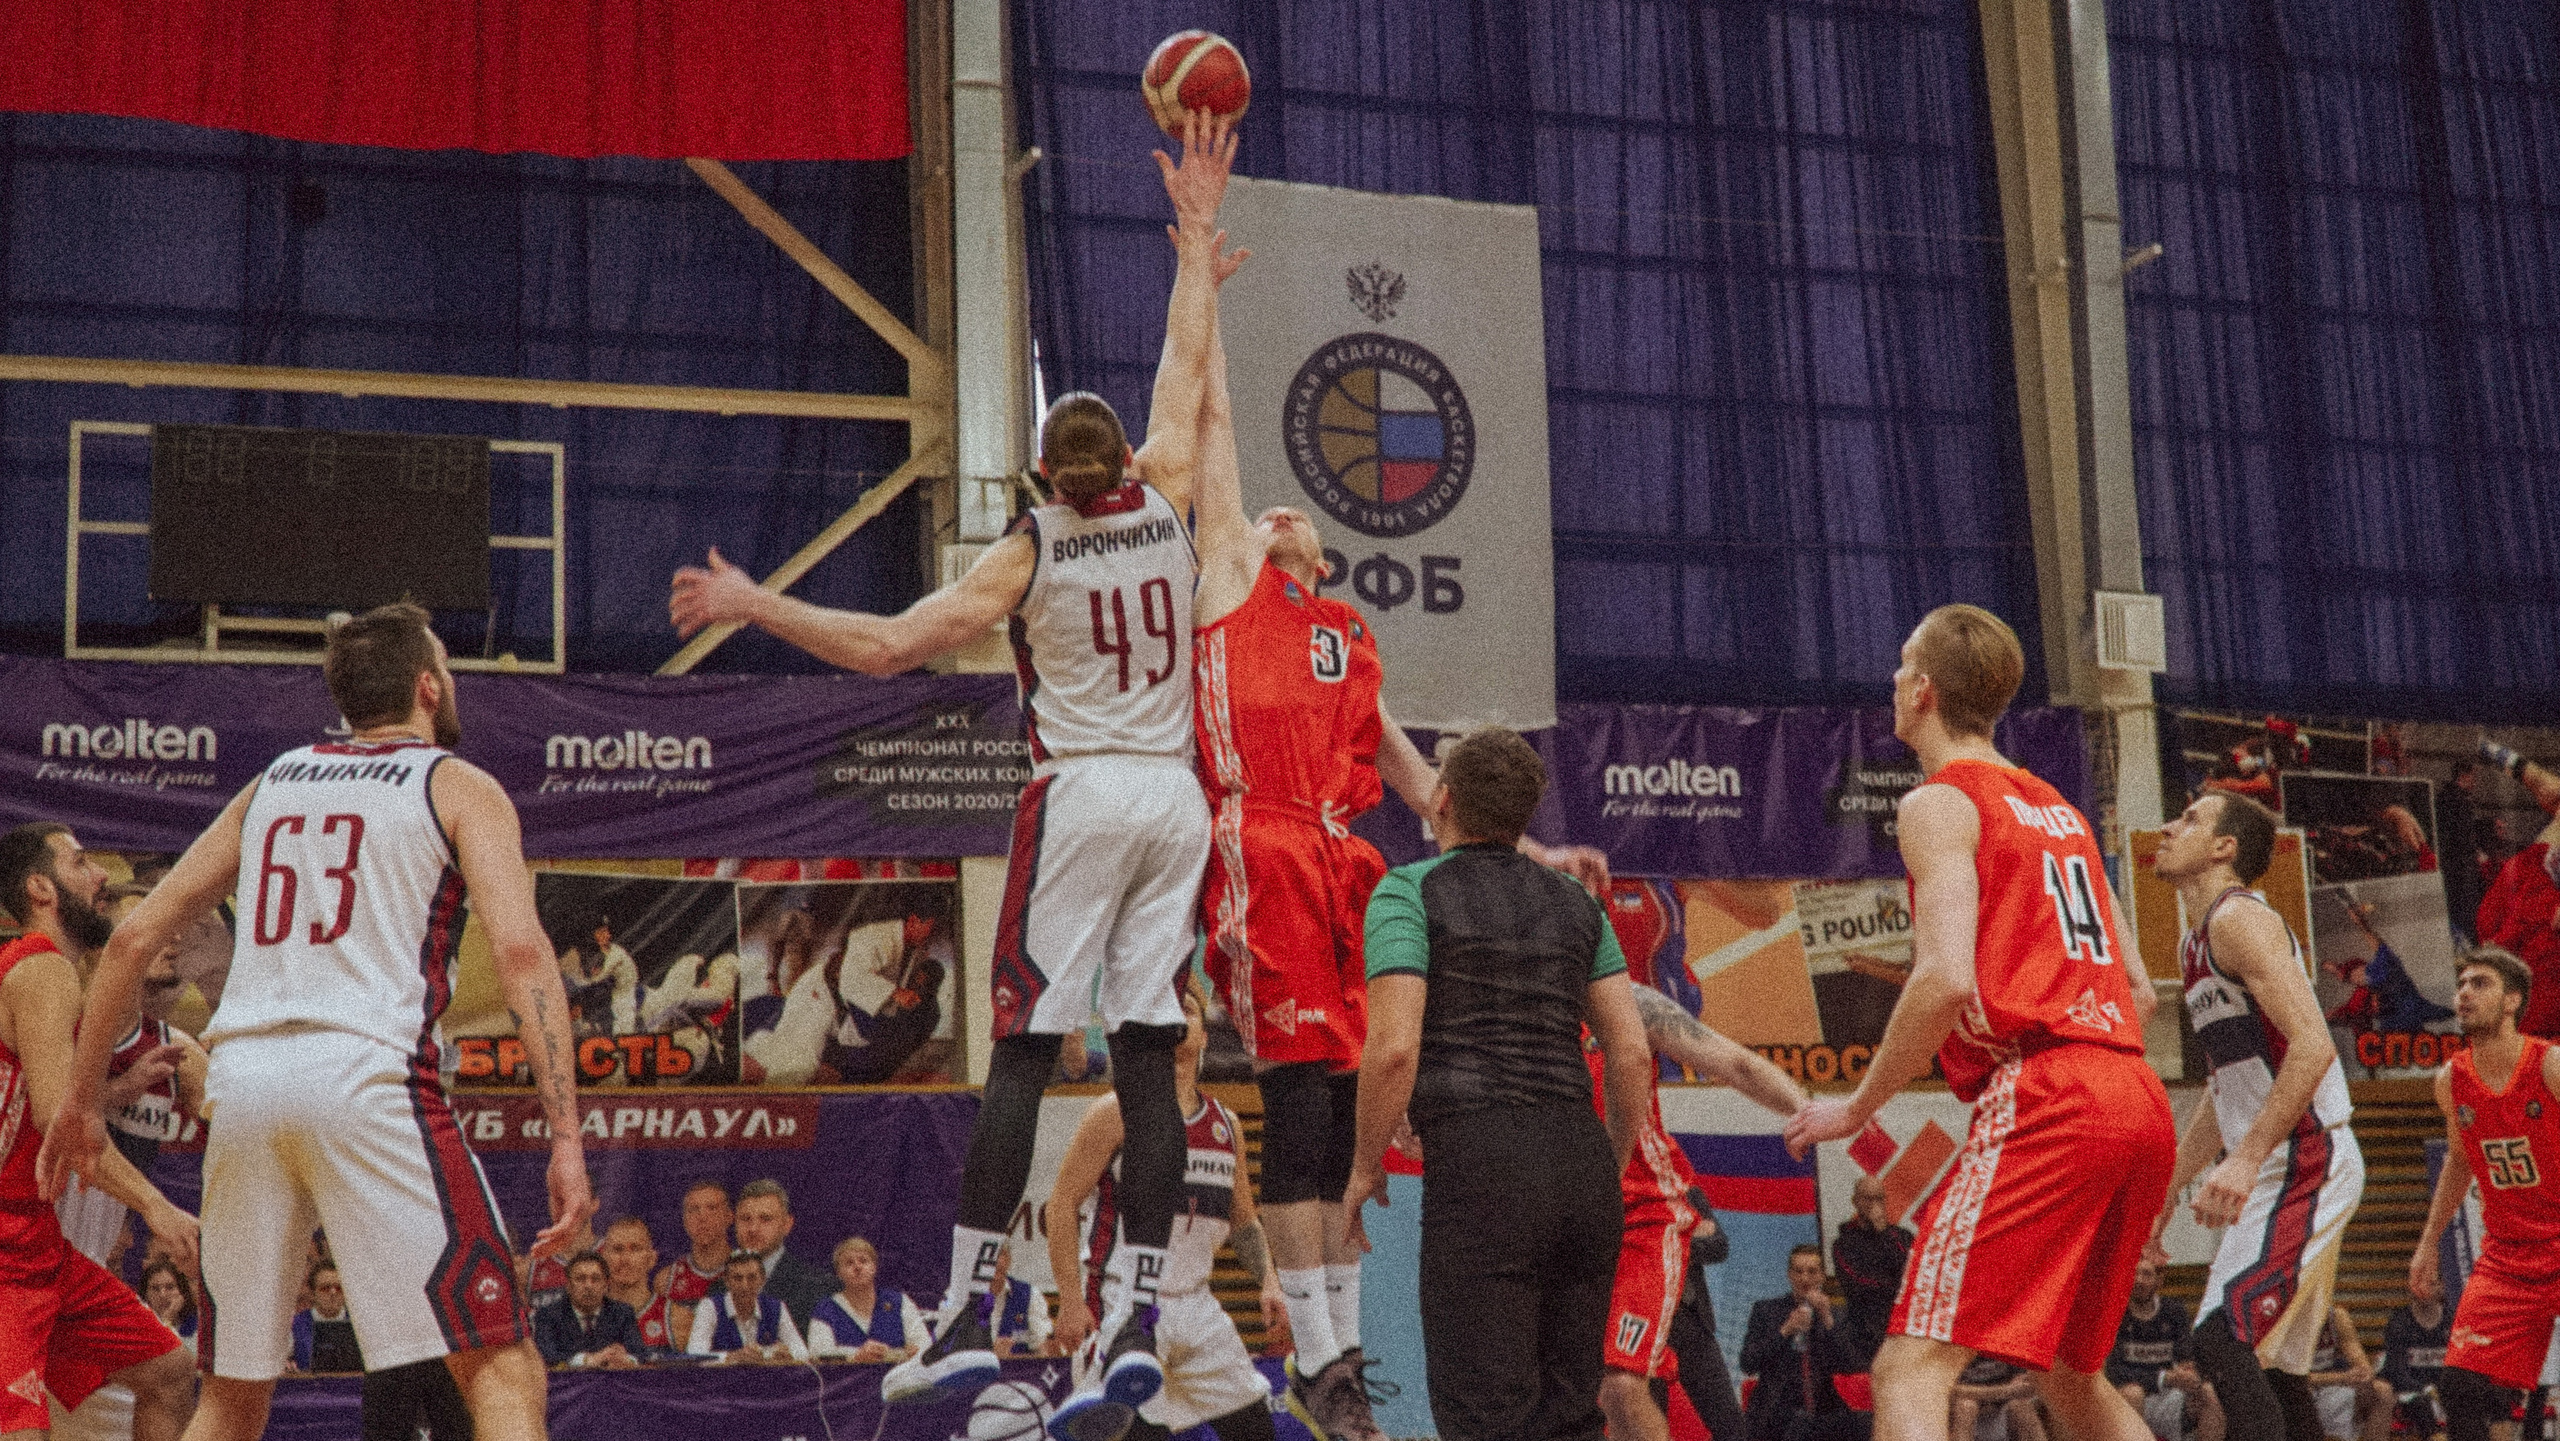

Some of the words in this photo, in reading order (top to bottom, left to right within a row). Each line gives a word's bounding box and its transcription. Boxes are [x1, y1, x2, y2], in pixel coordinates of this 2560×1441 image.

[1291, 373, 1351, 513] РОССИЙСКАЯ
[1324, 343, 1441, 383] ФЕДЕРАЦИЯ
[1416, 390, 1466, 516] БАСКЕТБОЛА
[1052, 518, 1176, 563] ВОРОНЧИХИН
[1315, 548, 1465, 615] РФБ
[1089, 577, 1176, 693] 49
[1311, 624, 1348, 684] 3
[42, 718, 217, 761] molten
[546, 730, 712, 770] molten
[856, 740, 968, 757] ЧЕМПИОНАТ
[36, 763, 71, 780] For
[73, 764, 104, 782] the
[110, 765, 157, 785] real
[156, 773, 216, 792] game
[539, 774, 572, 795] For
[575, 774, 609, 793] the
[613, 774, 657, 792] real
[656, 778, 713, 799] game
[834, 767, 895, 784] СРЕДИ
[900, 767, 990, 783] МУЖСКИХ
[1604, 758, 1741, 797] molten
[887, 793, 950, 811] СЕЗОН
[1602, 800, 1631, 818] For
[1632, 800, 1659, 817] the
[1662, 800, 1695, 818] real
[1696, 806, 1743, 824] game
[254, 814, 365, 947] 63
[2043, 851, 2113, 965] 14
[458, 1036, 693, 1077] БРСТЬ
[522, 1108, 797, 1140] «АРНАУЛ»
[2481, 1136, 2541, 1190] 55
[1615, 1311, 1650, 1357] 17
